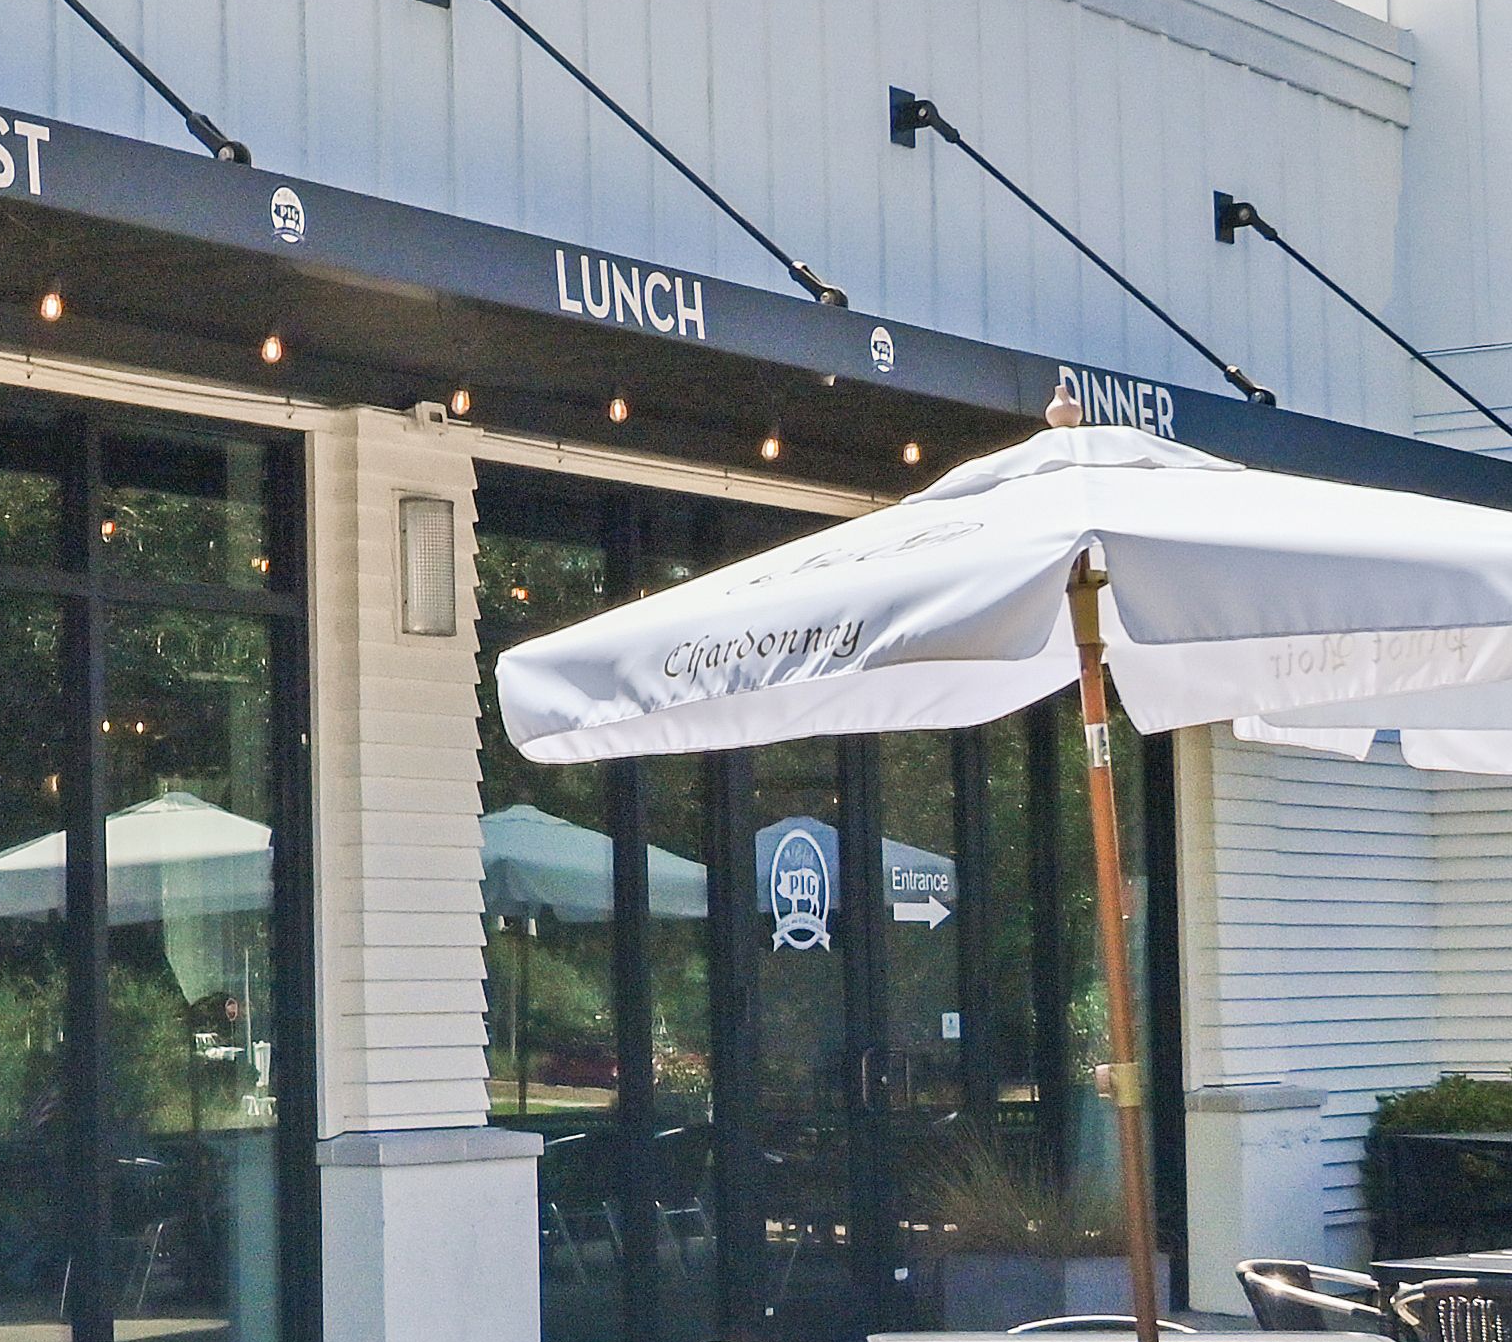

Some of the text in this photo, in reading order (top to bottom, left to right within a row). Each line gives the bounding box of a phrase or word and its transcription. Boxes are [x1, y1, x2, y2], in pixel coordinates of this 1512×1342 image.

[554, 249, 706, 340] LUNCH
[1058, 365, 1176, 439] DINNER
[663, 619, 865, 685] Chardonnay
[788, 874, 818, 896] PIG
[890, 865, 950, 894] Entrance
